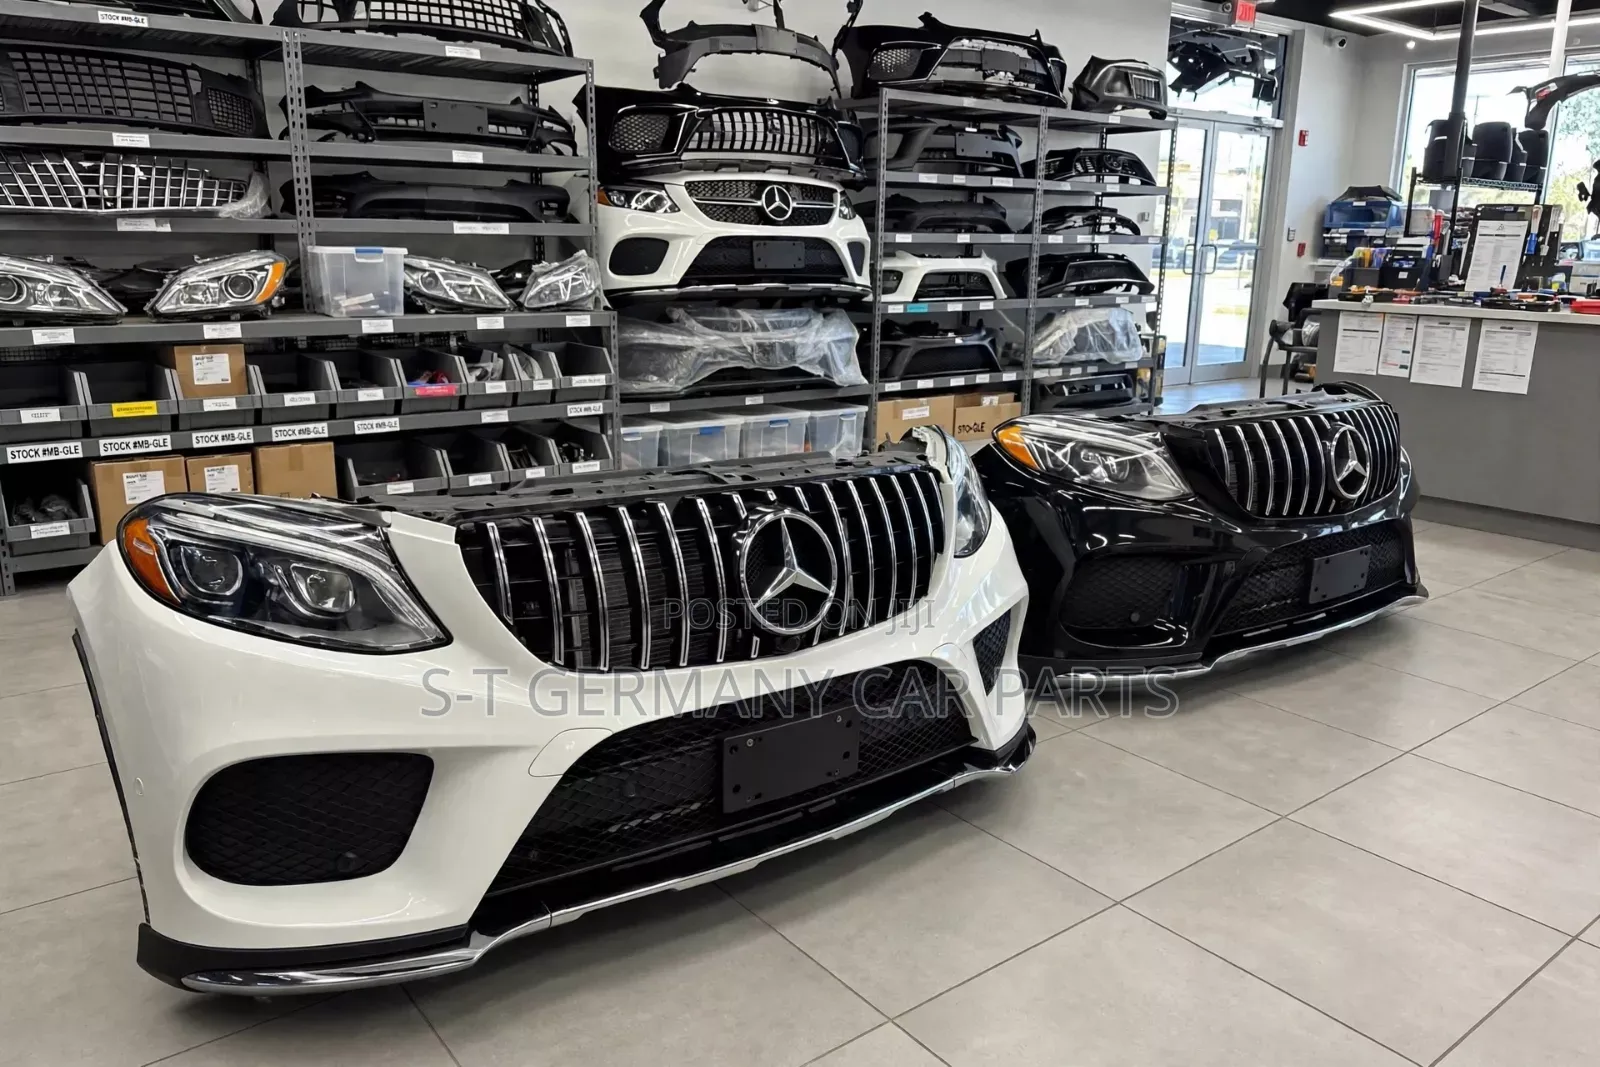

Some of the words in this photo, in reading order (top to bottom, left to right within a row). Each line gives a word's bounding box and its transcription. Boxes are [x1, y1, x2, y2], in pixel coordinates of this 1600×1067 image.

[195, 434, 219, 444] STOCK
[221, 431, 252, 442] #MB-GLE
[274, 428, 297, 438] STOCK
[297, 426, 326, 436] #MB-GLE
[102, 441, 132, 452] STOCK
[132, 437, 168, 449] #MB-GLE
[10, 448, 41, 460] STOCK
[42, 445, 80, 457] #MB-GLE
